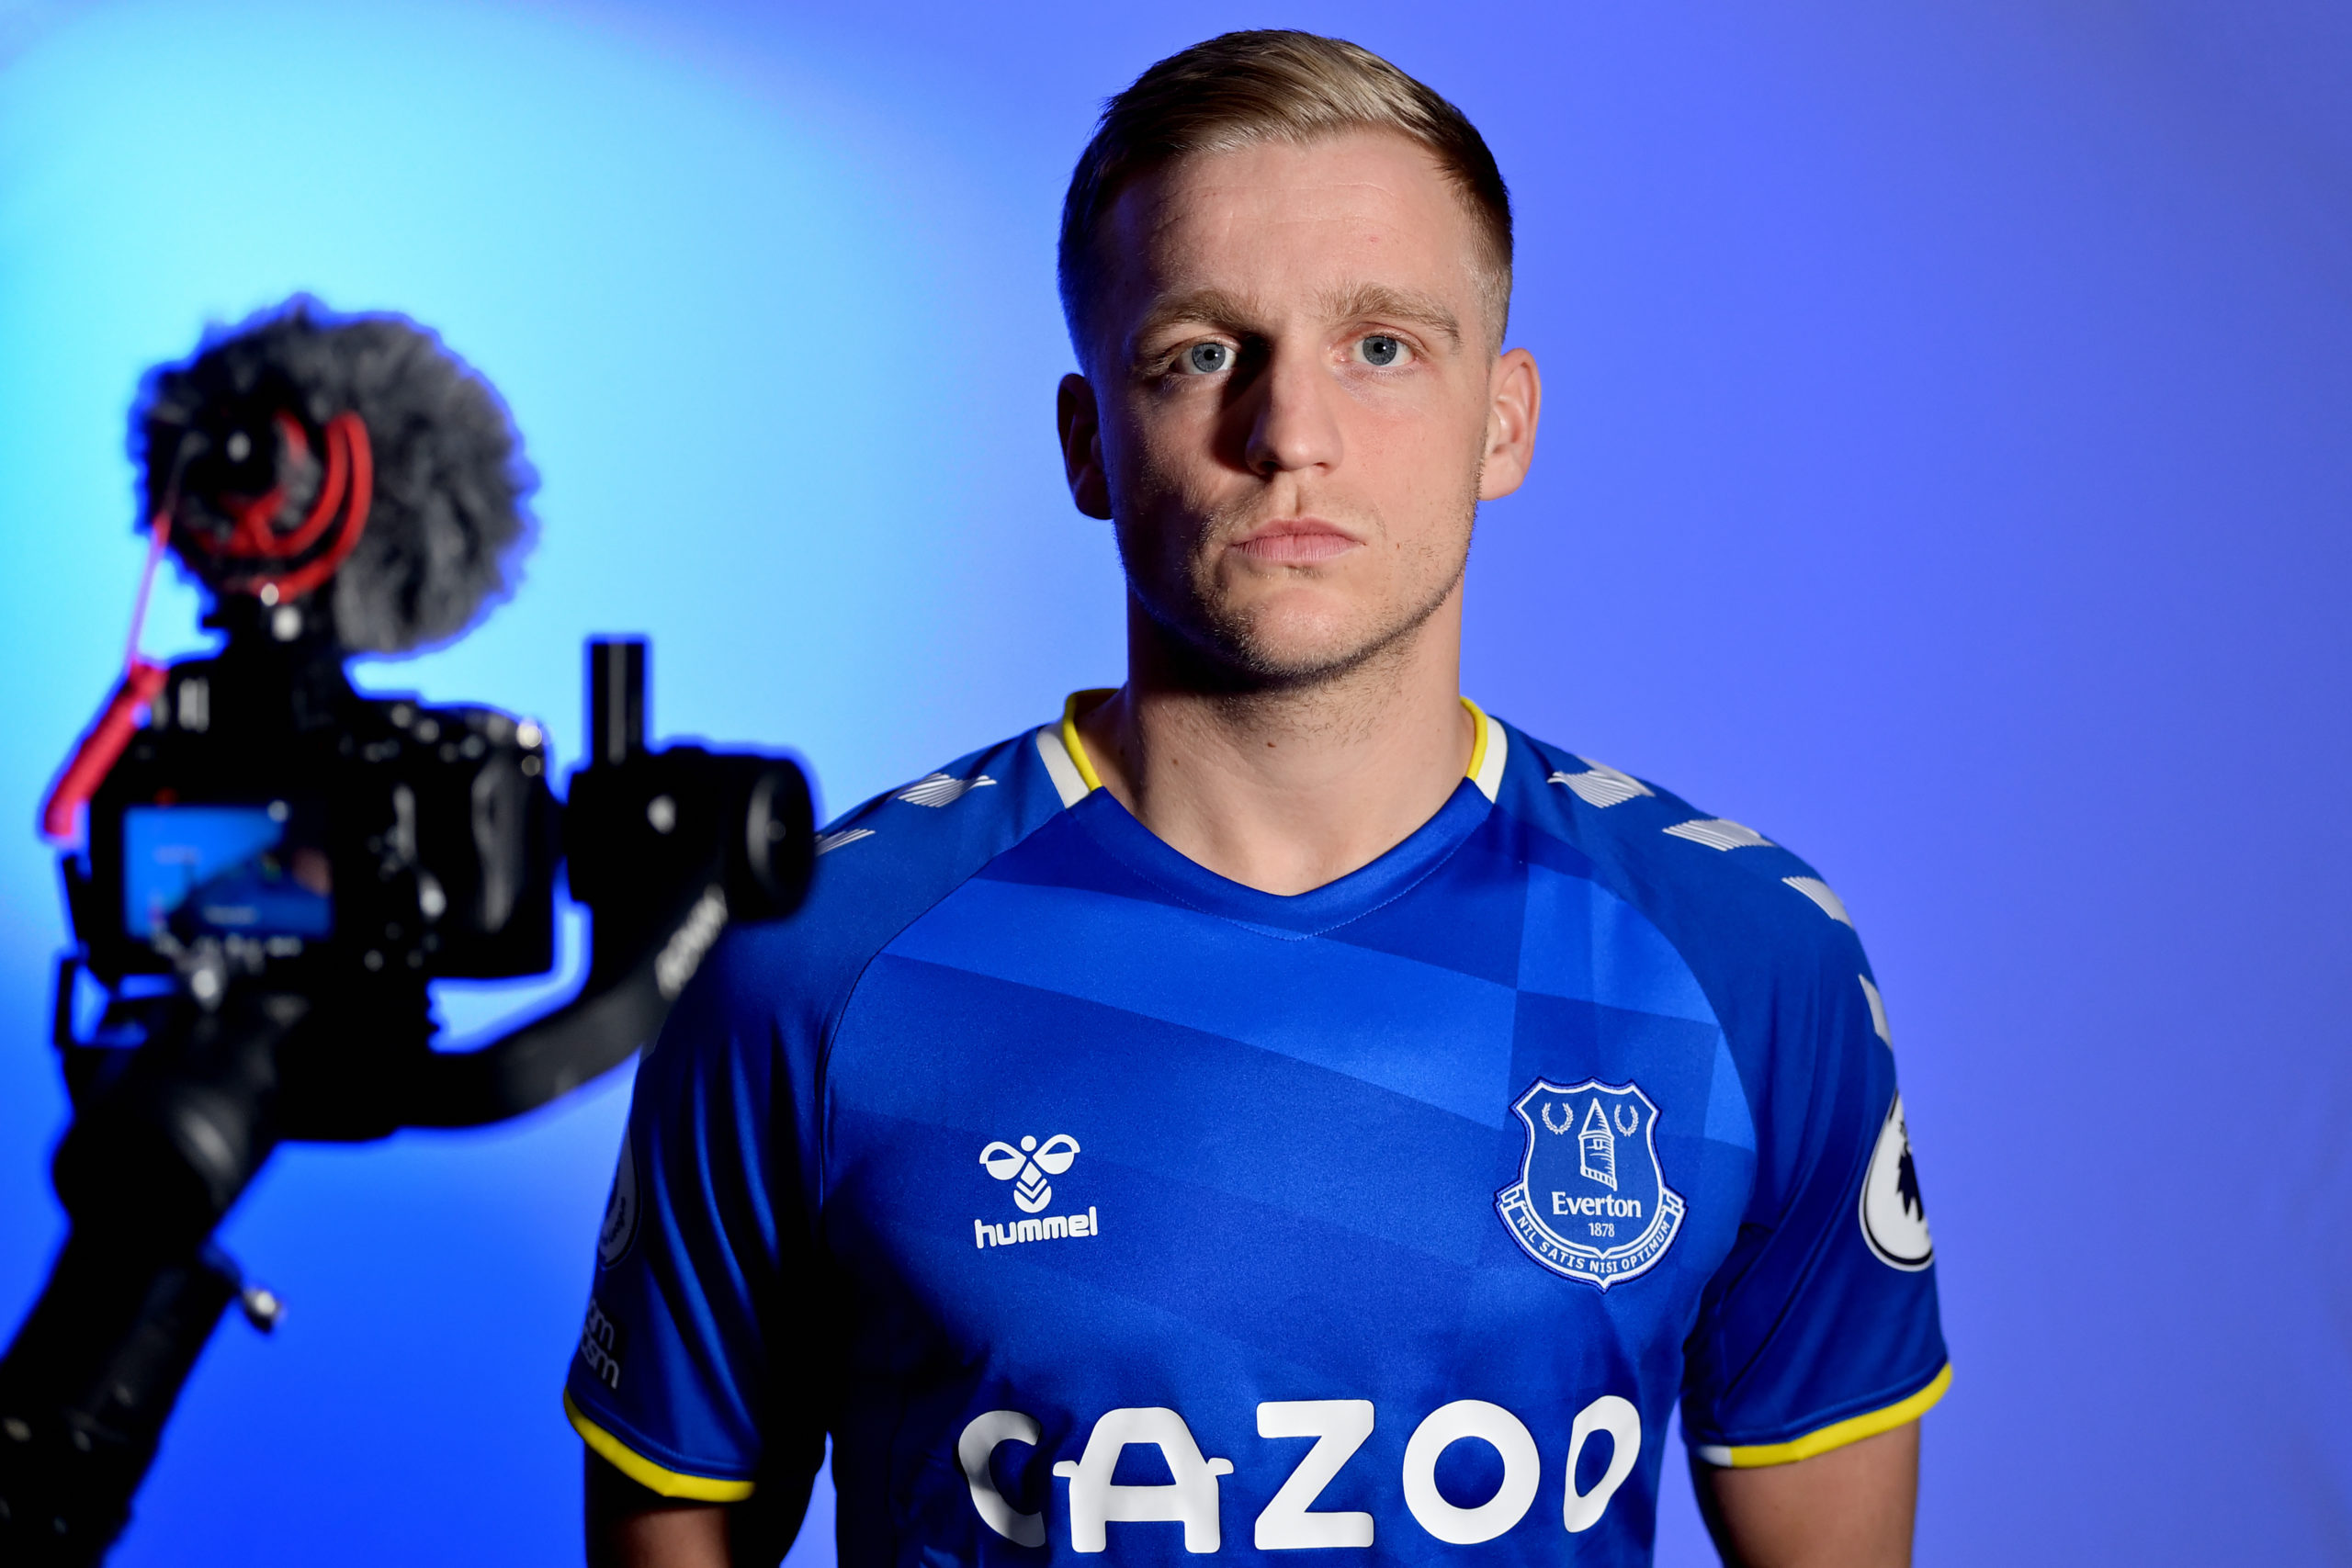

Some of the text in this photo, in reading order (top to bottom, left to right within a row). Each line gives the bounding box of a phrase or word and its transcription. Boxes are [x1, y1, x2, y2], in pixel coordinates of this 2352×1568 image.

[1552, 1191, 1642, 1218] Everton
[974, 1205, 1099, 1249] hummel
[1517, 1215, 1671, 1274] NIL SATIS NISI OPTIMUM
[1588, 1223, 1616, 1238] 1878
[957, 1394, 1643, 1554] CAZOO
